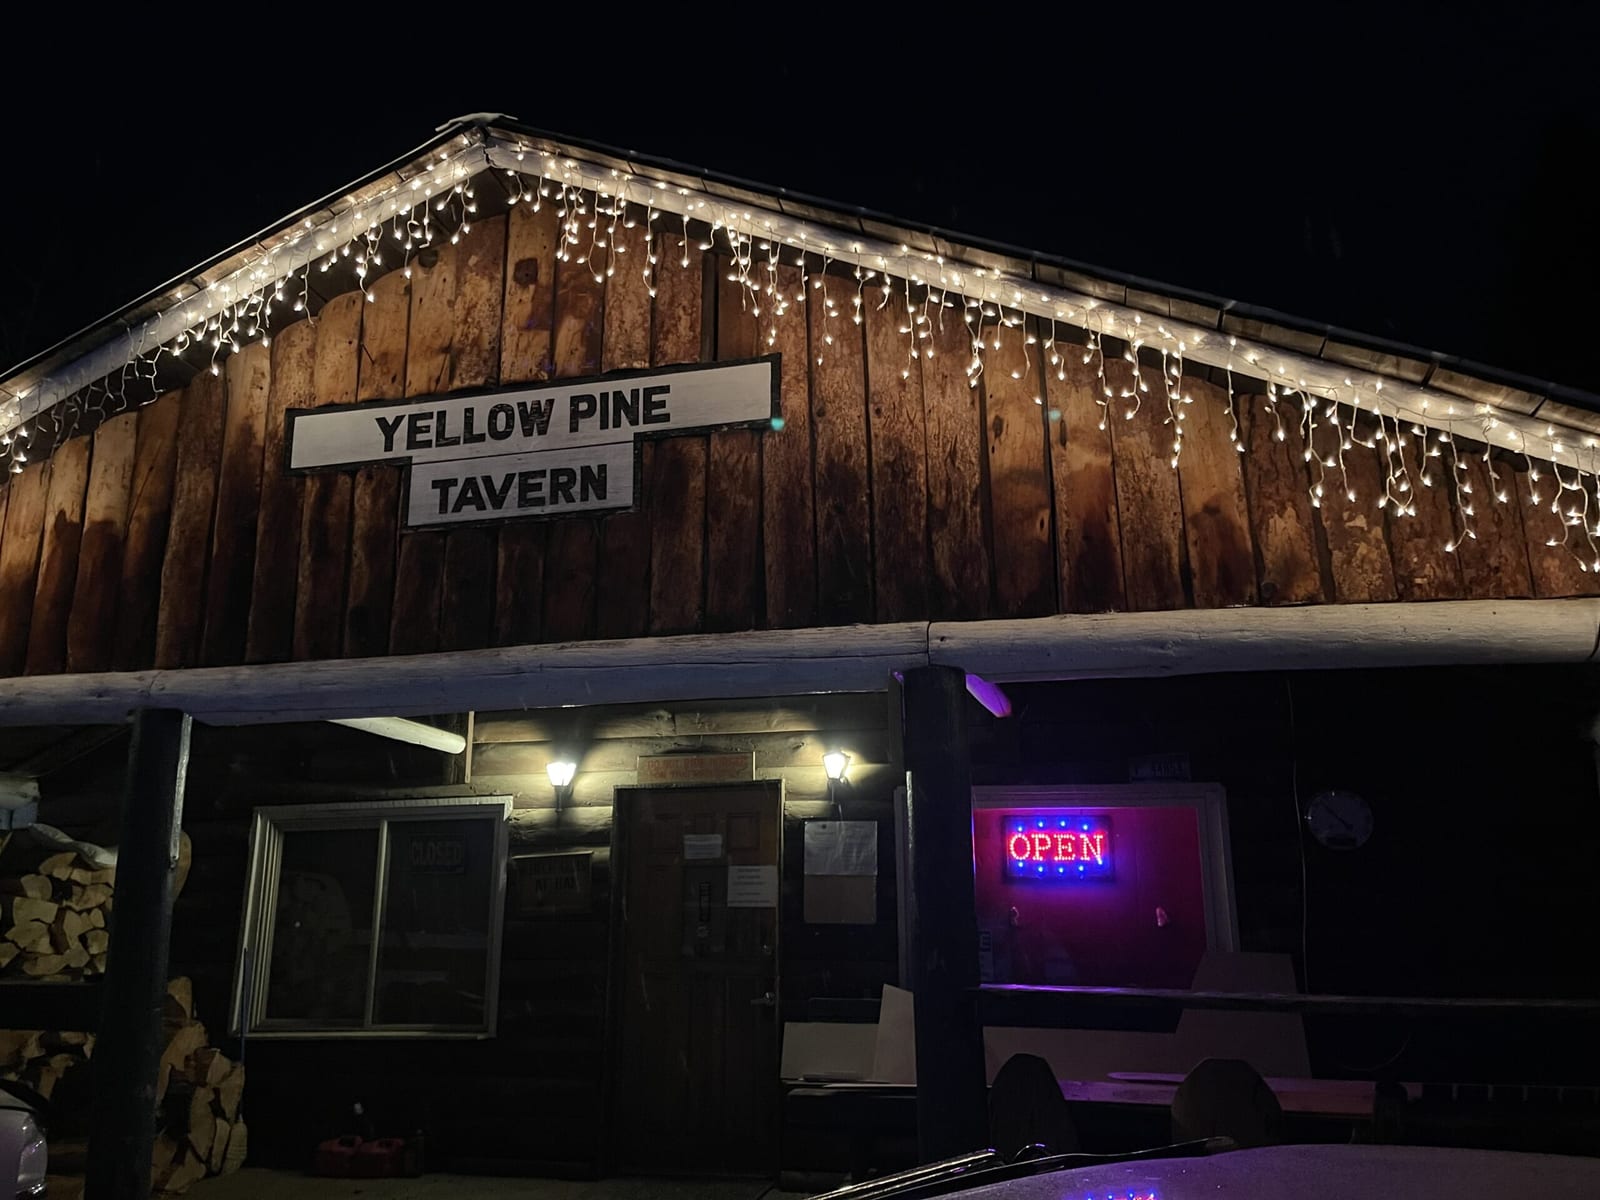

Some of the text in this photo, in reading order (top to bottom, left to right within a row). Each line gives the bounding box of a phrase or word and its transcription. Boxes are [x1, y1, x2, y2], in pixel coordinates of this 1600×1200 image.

[375, 385, 671, 452] YELLOW PINE
[430, 464, 608, 514] TAVERN
[411, 840, 461, 866] CLOSED
[1008, 833, 1104, 866] OPEN
